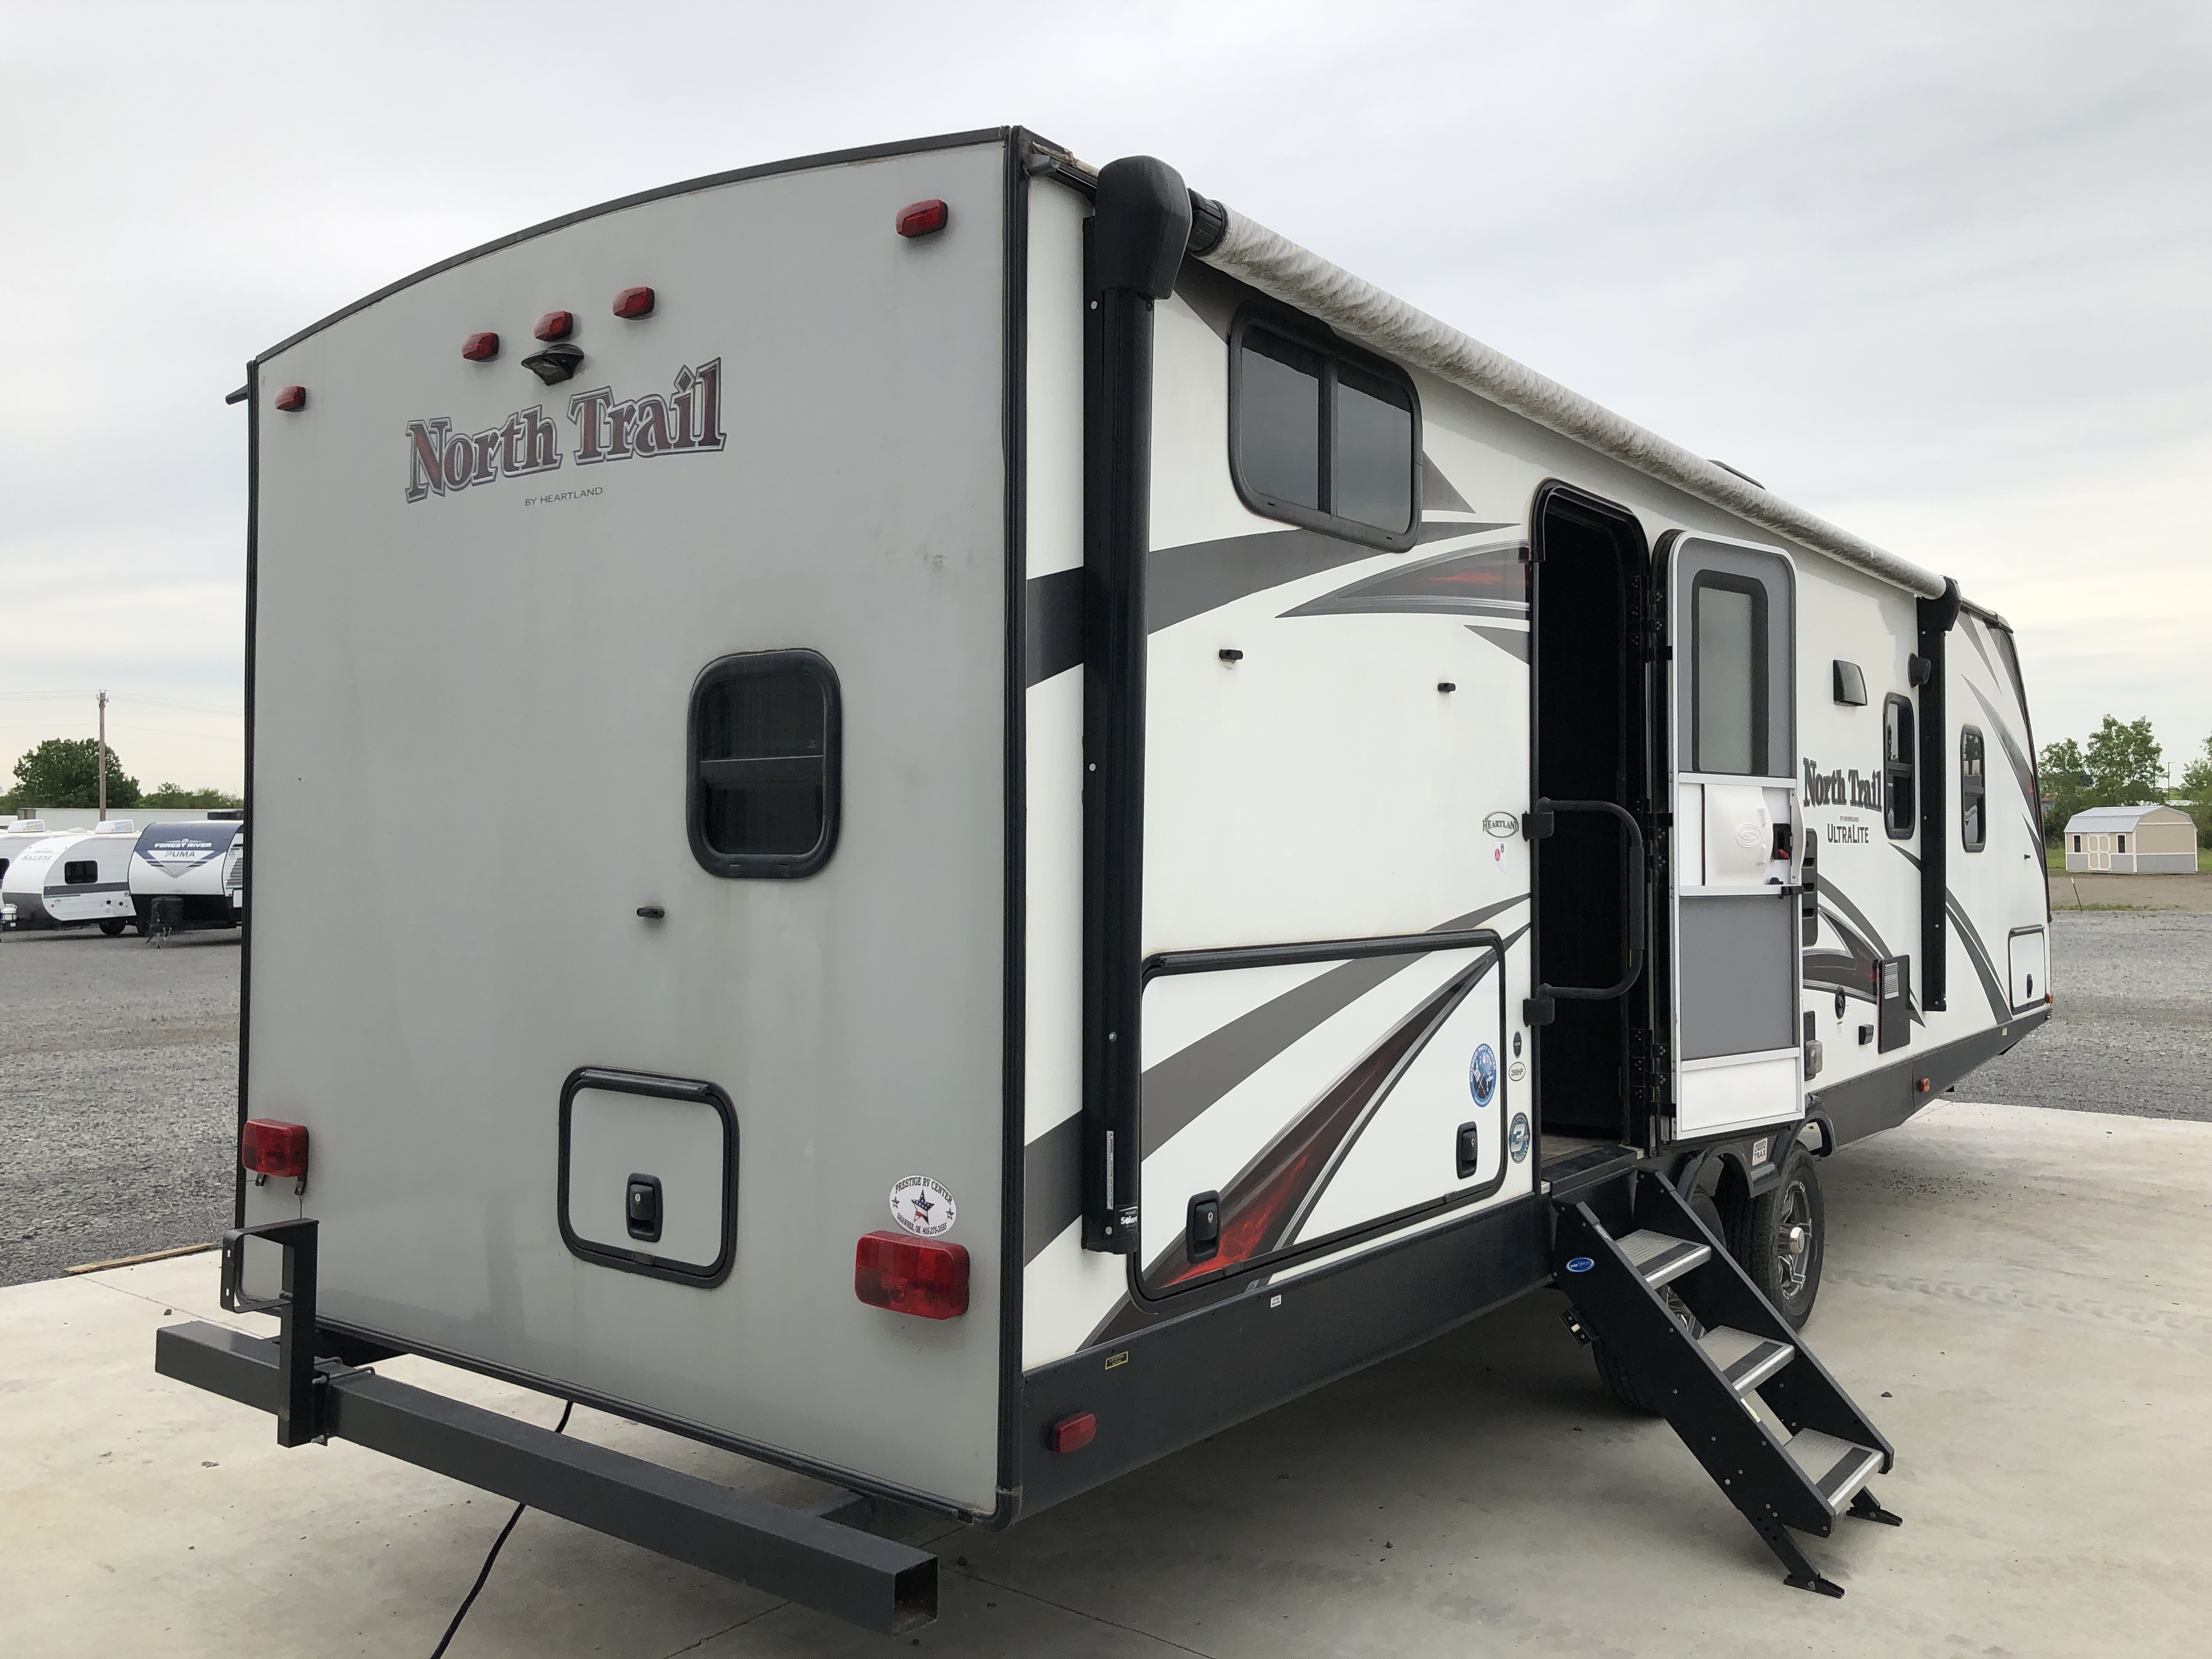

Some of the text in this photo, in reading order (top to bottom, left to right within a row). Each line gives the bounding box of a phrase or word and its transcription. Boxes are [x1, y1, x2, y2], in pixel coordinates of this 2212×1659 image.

[406, 357, 727, 503] North Trail
[525, 487, 603, 506] BY HEARTLAND
[1803, 757, 1882, 813] North Trail
[1482, 819, 1519, 832] HEARTLAND
[1470, 1051, 1479, 1082] OUTDOOR
[1488, 1048, 1496, 1070] CENTER
[1511, 1124, 1525, 1152] 3
[1754, 1149, 1766, 1160] TRAX
[895, 1177, 953, 1205] PRESTIGE RV CENTER
[916, 1225, 921, 1233] OK
